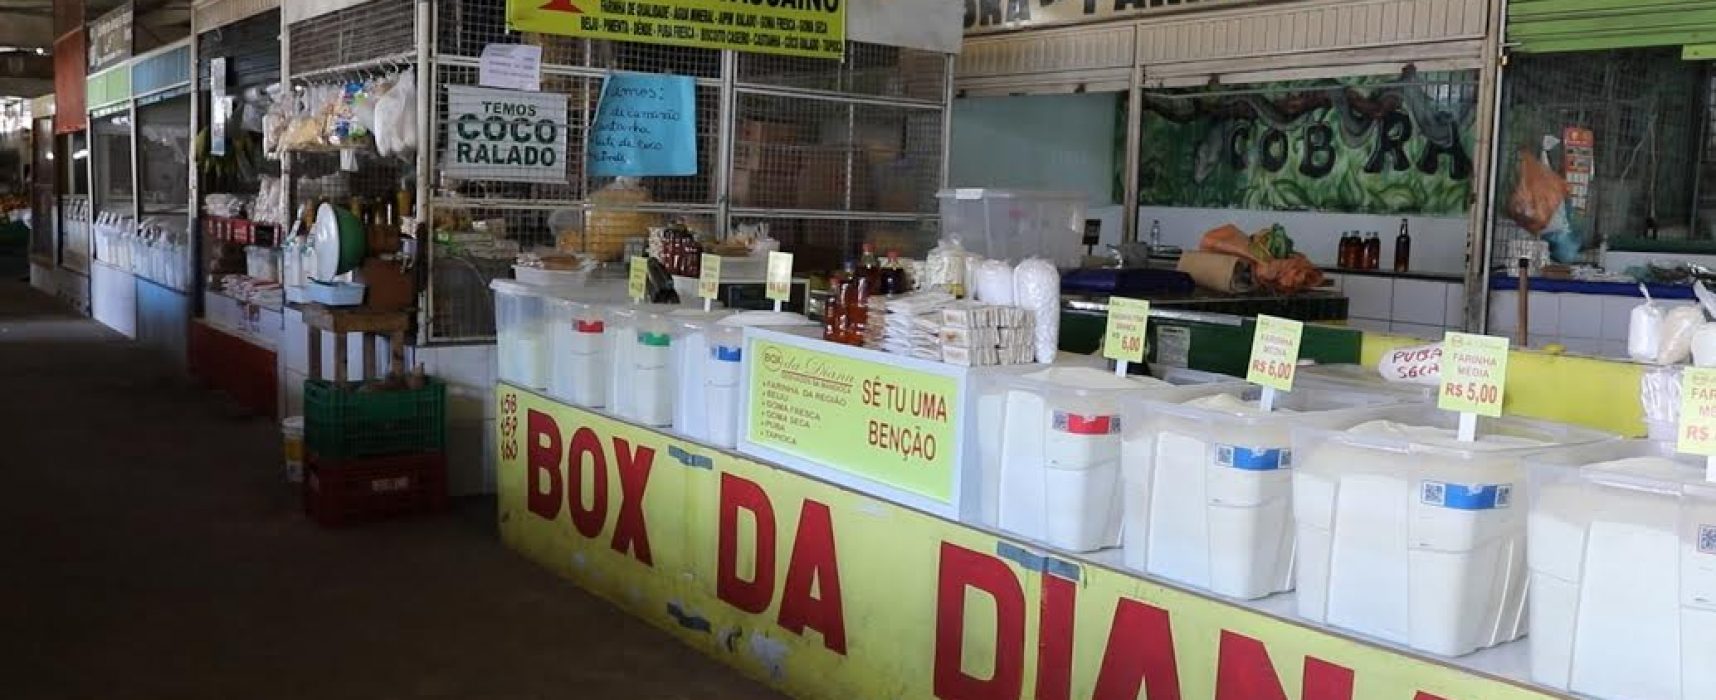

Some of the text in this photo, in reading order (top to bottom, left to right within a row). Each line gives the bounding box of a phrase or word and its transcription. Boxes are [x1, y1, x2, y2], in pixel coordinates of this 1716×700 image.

[481, 101, 537, 117] TEMOS
[457, 113, 557, 144] COCO
[457, 142, 557, 167] RALADO
[1253, 359, 1267, 373] R$
[1392, 348, 1442, 363] PUBA
[1453, 353, 1497, 366] FARINHA
[806, 356, 855, 382] Diana
[766, 380, 847, 407] FARINHA DA REGIÃO
[862, 376, 948, 424] SÊ TU UMA
[1445, 382, 1498, 404] R$ 5,00
[766, 399, 821, 420] GOMA FRESCA
[766, 409, 810, 428] GOMA SECA
[766, 429, 797, 444] TAPIOCA
[869, 420, 937, 462] BENÇÃO
[527, 408, 1455, 700] BOX DA DIA
